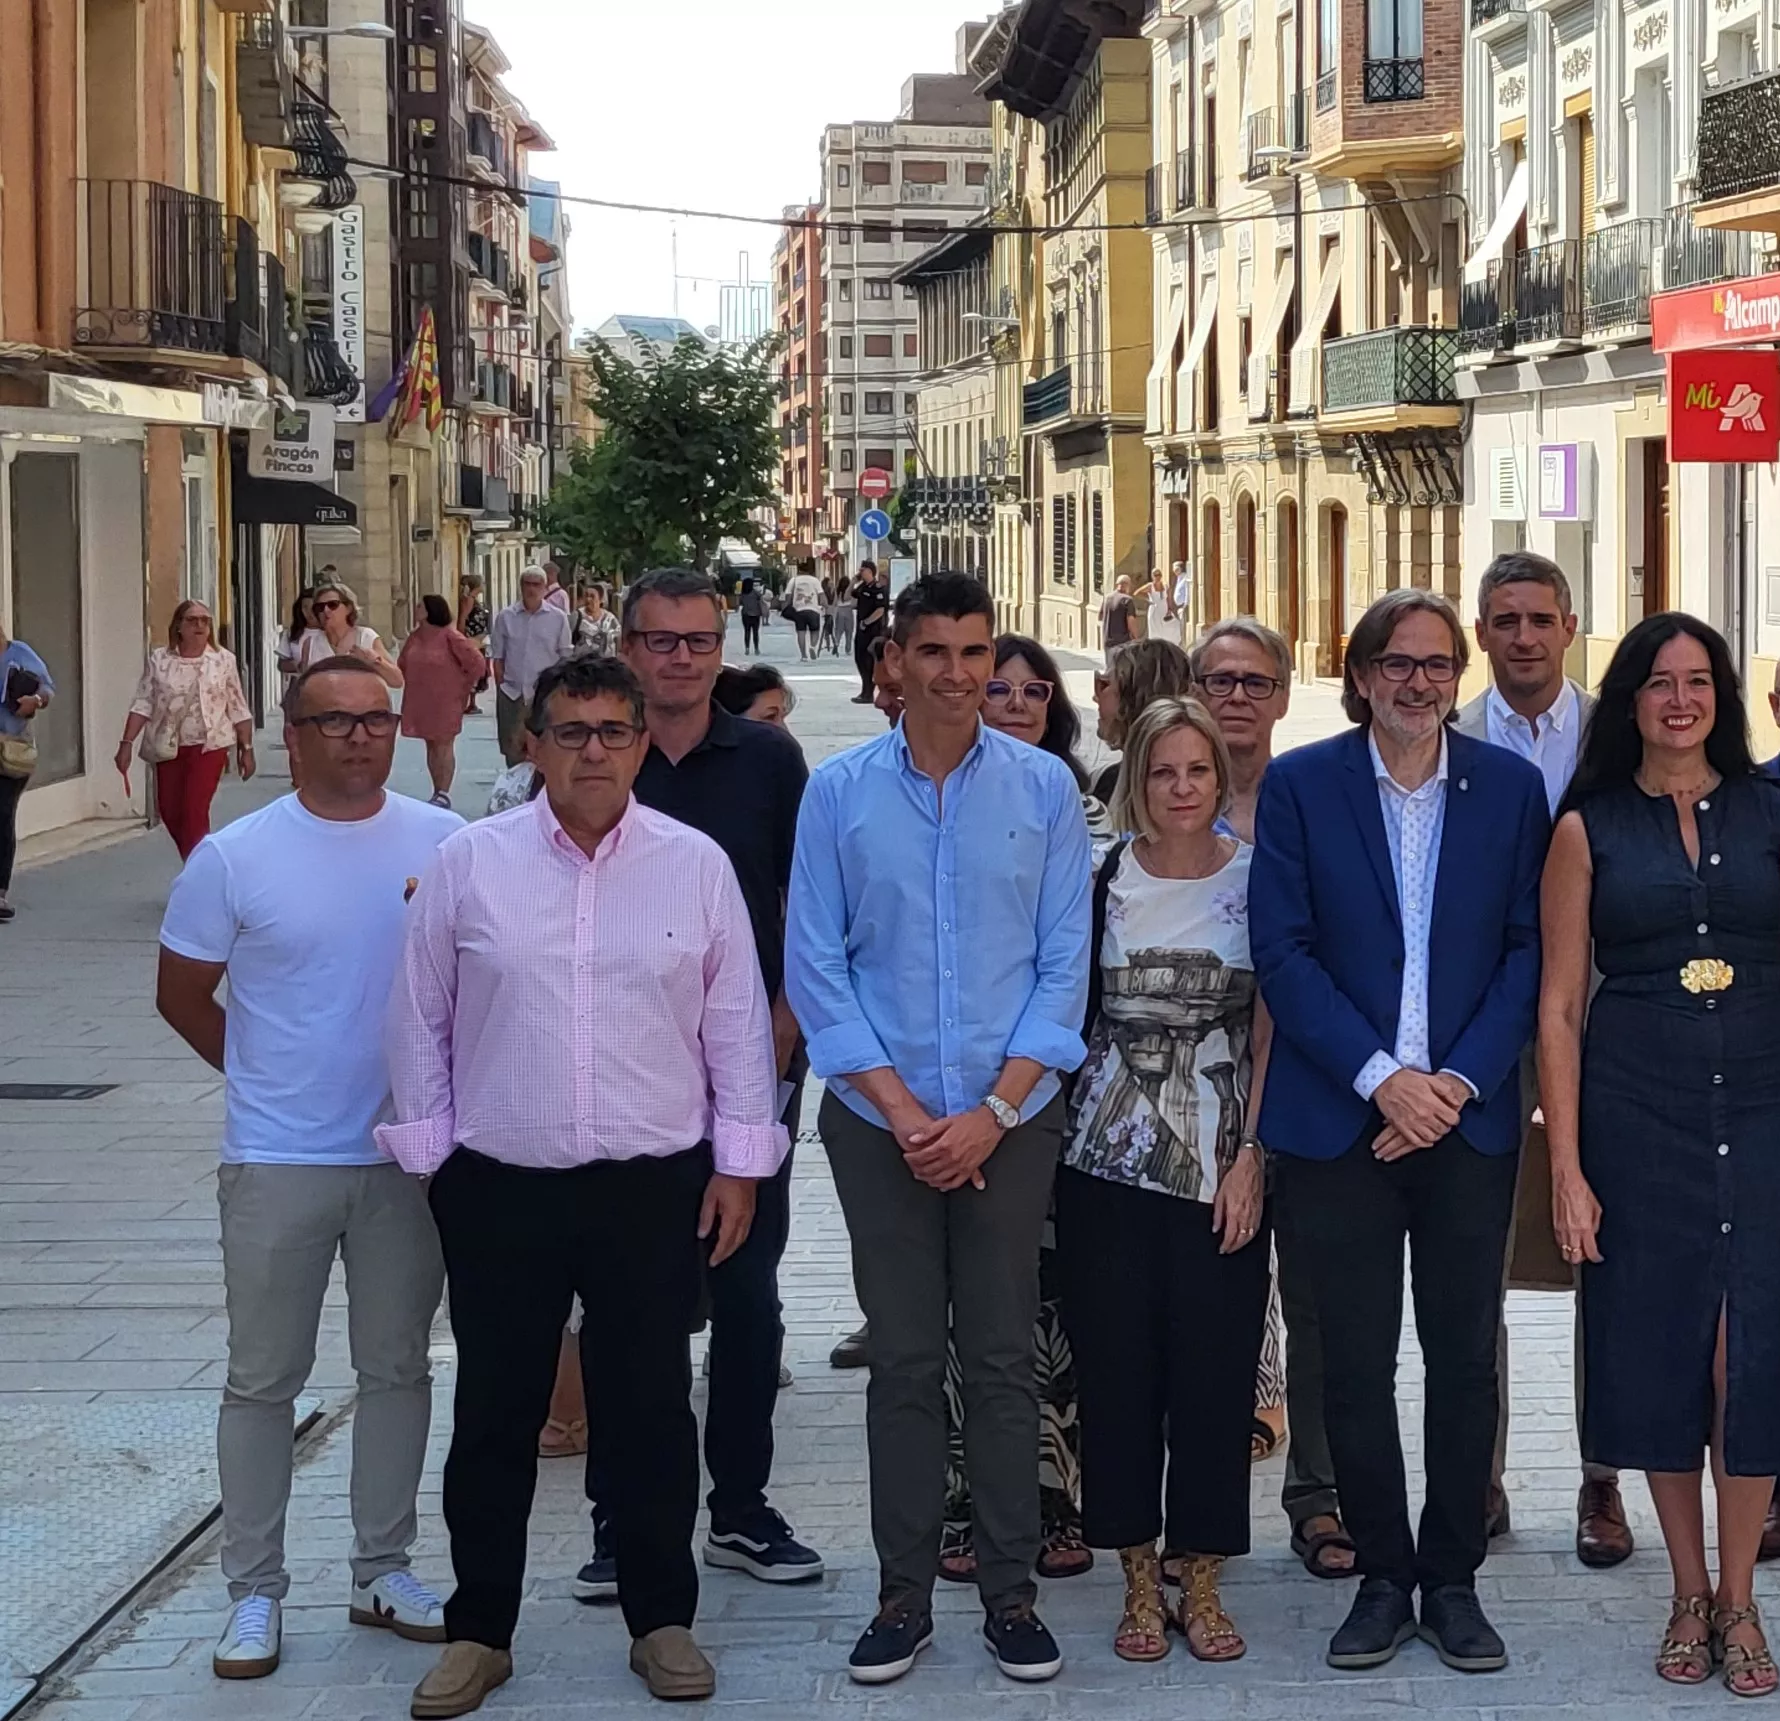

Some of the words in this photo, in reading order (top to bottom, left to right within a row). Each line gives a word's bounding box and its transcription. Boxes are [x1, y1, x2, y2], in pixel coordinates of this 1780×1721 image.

[338, 210, 358, 281] Gastro
[1685, 381, 1721, 410] Mi
[262, 444, 319, 461] Aragón
[265, 459, 314, 474] Fincas
